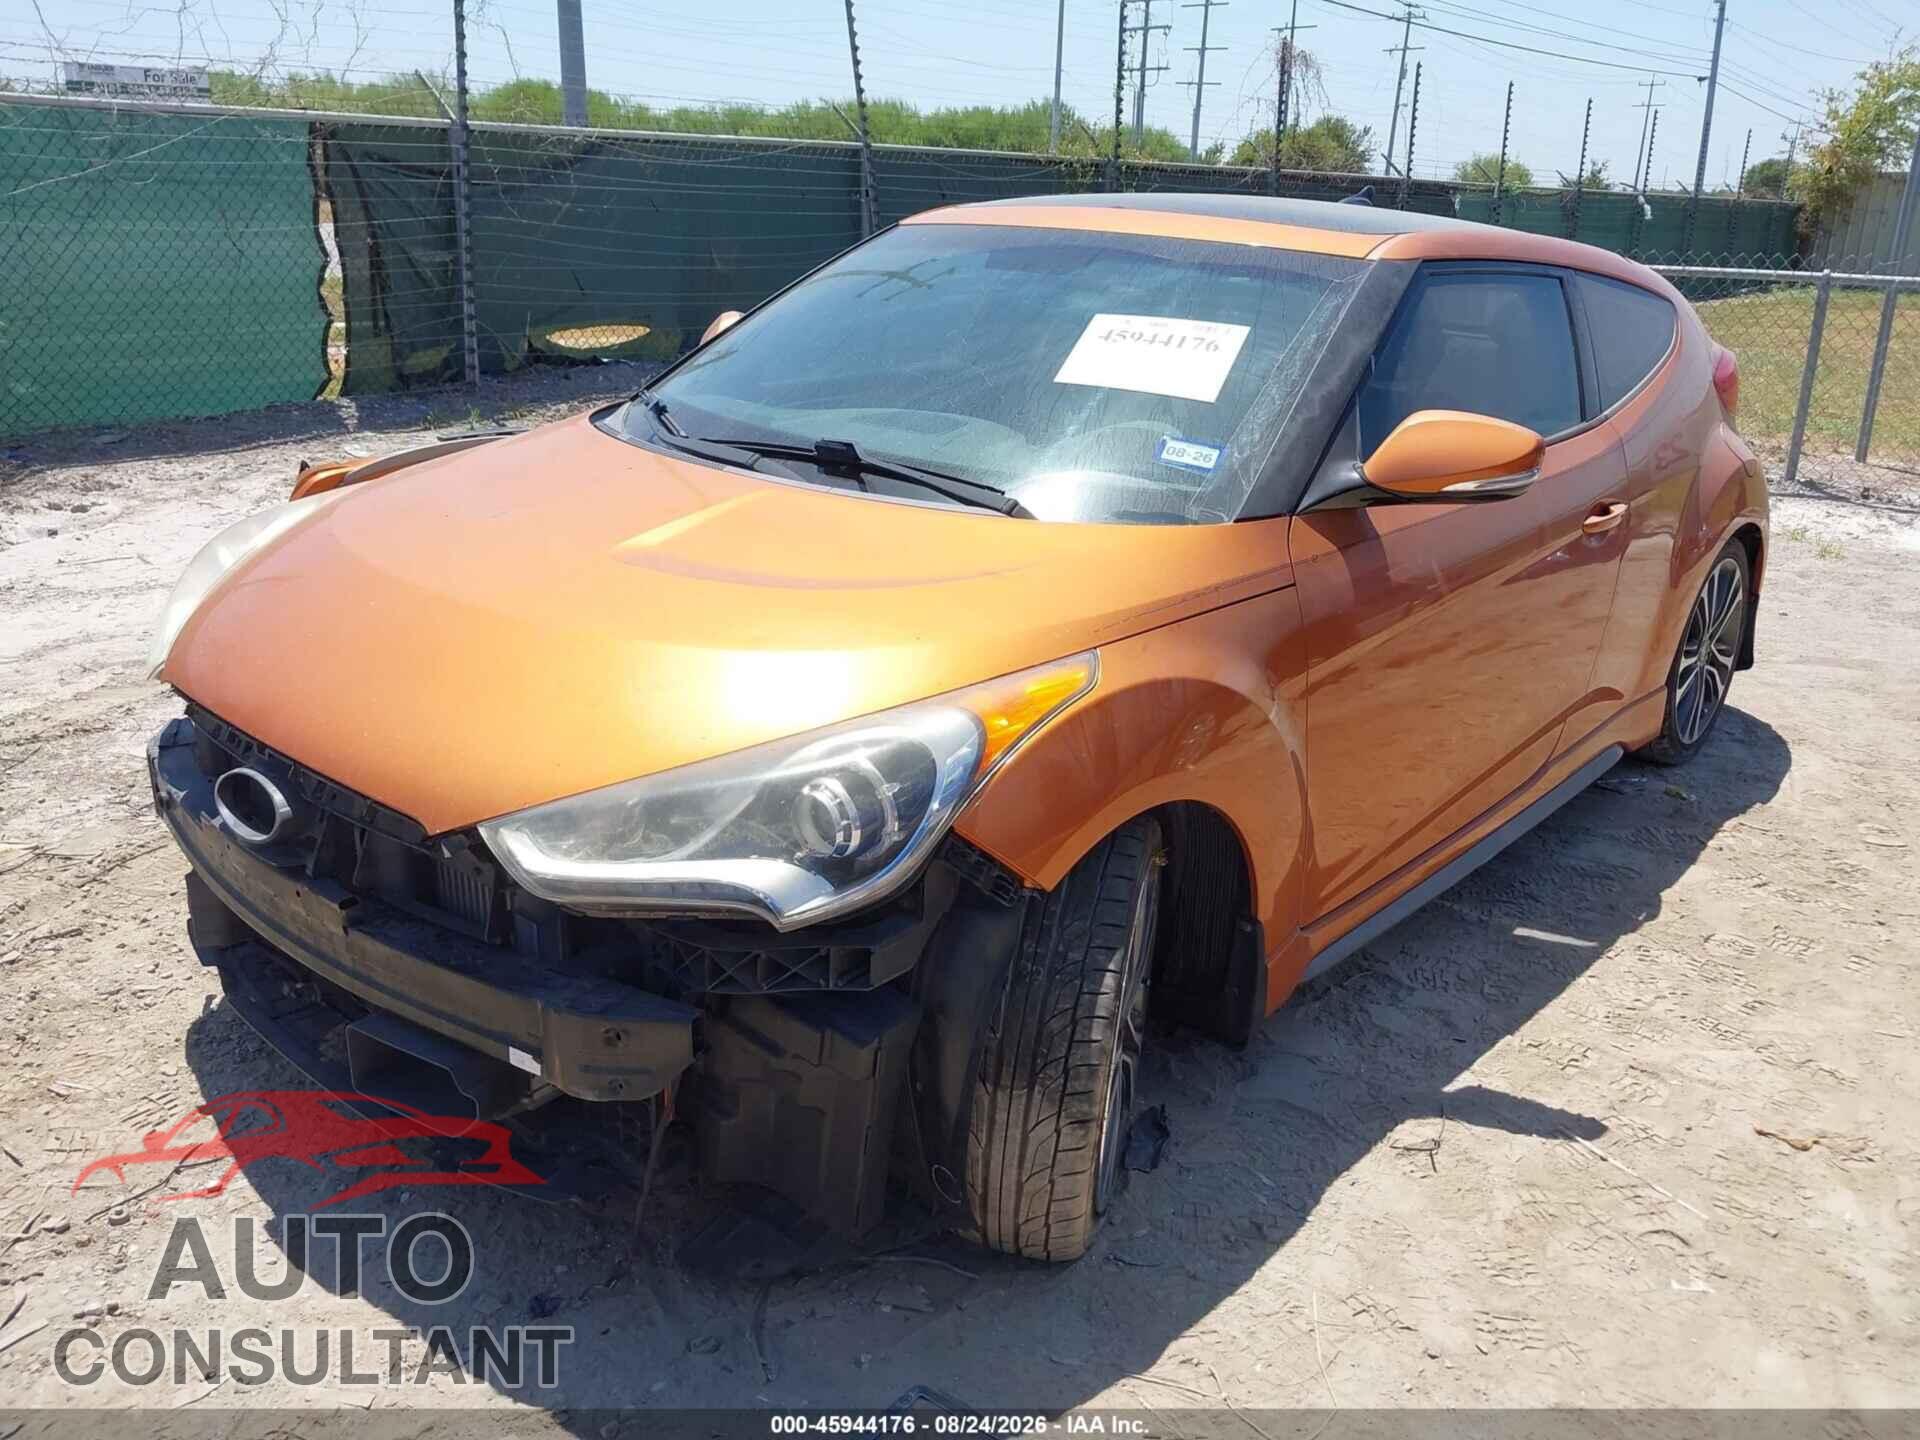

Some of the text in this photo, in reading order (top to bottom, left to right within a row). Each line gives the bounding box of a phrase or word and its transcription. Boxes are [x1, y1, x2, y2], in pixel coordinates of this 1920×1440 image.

[143, 69, 198, 85] For Sale
[1096, 329, 1220, 353] 45944176
[1165, 446, 1213, 464] 08-26
